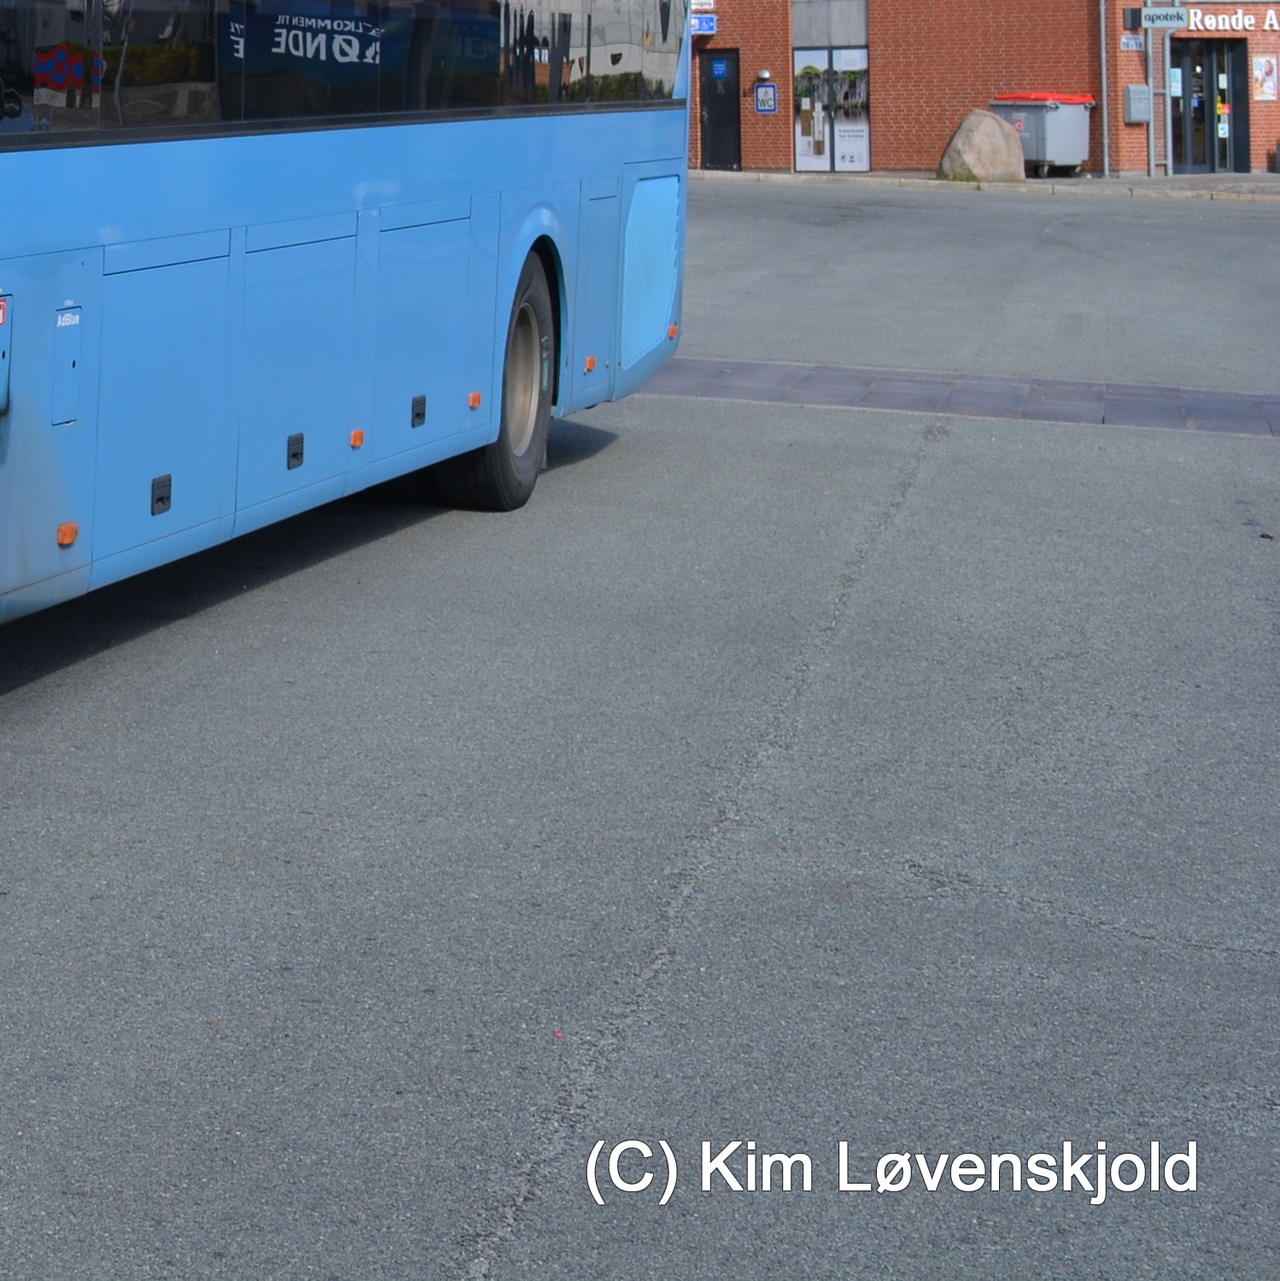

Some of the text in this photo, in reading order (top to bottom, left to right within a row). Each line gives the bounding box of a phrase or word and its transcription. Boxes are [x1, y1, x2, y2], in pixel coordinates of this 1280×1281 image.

[1144, 12, 1184, 24] apotek
[1188, 8, 1256, 31] Rønde
[759, 99, 773, 108] WC
[56, 312, 80, 327] AdBlue
